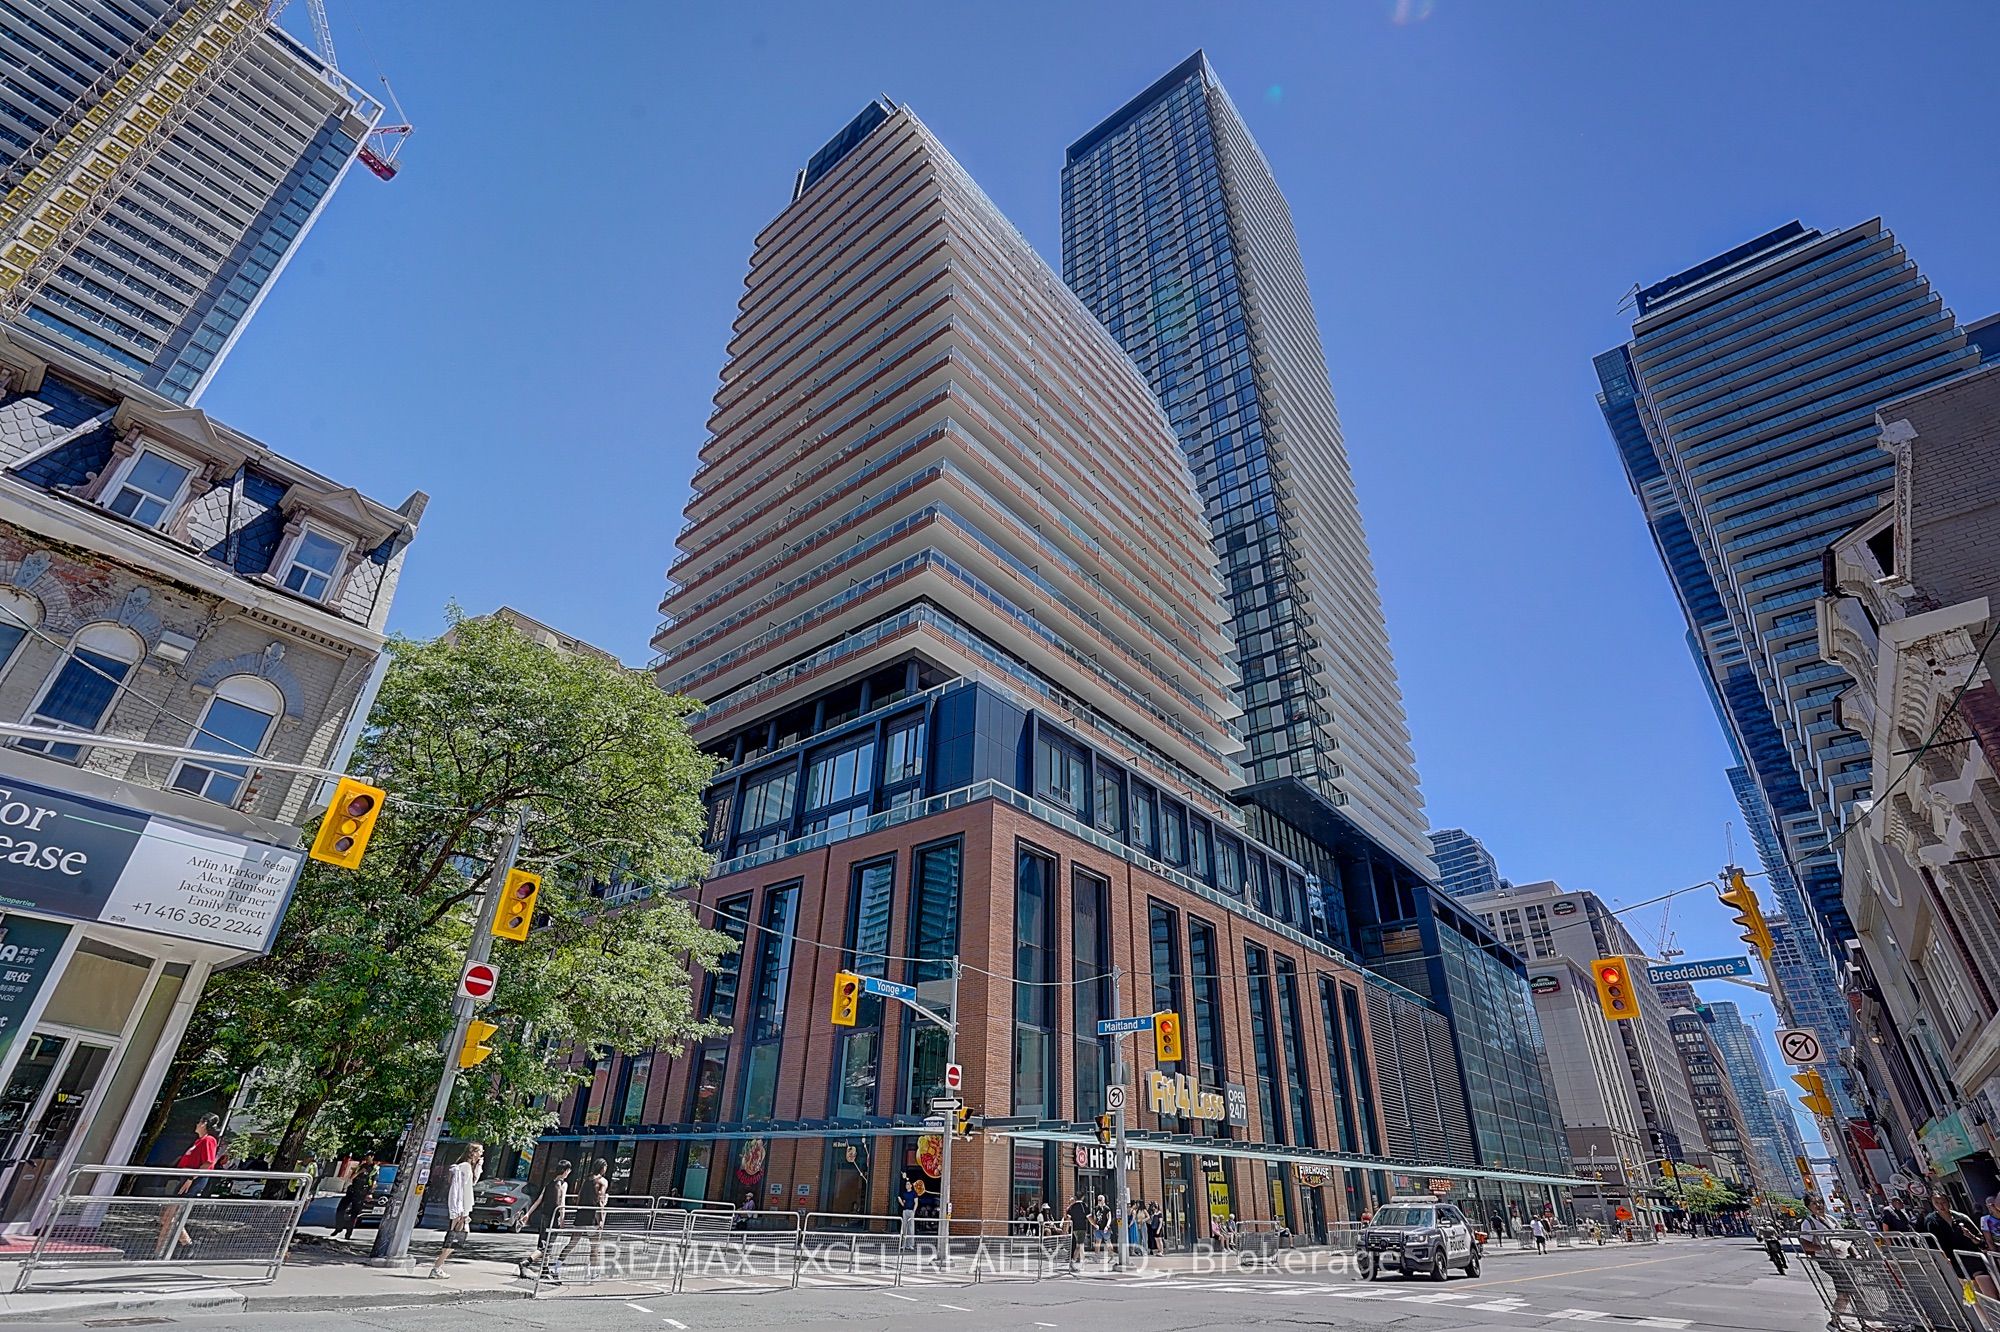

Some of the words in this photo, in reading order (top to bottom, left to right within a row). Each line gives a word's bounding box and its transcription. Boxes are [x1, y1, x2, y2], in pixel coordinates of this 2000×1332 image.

[0, 789, 57, 831] or
[187, 856, 218, 871] Arlin
[262, 860, 291, 873] Retail
[196, 871, 223, 885] Alex
[178, 880, 225, 898] Jackson
[187, 895, 224, 912] Emily
[132, 902, 151, 915] +1
[154, 905, 186, 922] 416
[188, 911, 221, 929] 362
[223, 919, 263, 937] 2244
[3, 970, 31, 983] 职位
[1649, 963, 1734, 982] Breadalbane
[877, 980, 900, 996] Yonge
[1104, 1020, 1138, 1032] Maitland
[1228, 1089, 1246, 1104] OPEN
[1229, 1103, 1247, 1120] 24/7
[1090, 1147, 1105, 1169] Hi
[1300, 1166, 1329, 1180] FIREHOUSE
[1450, 1239, 1466, 1251] POLICE
